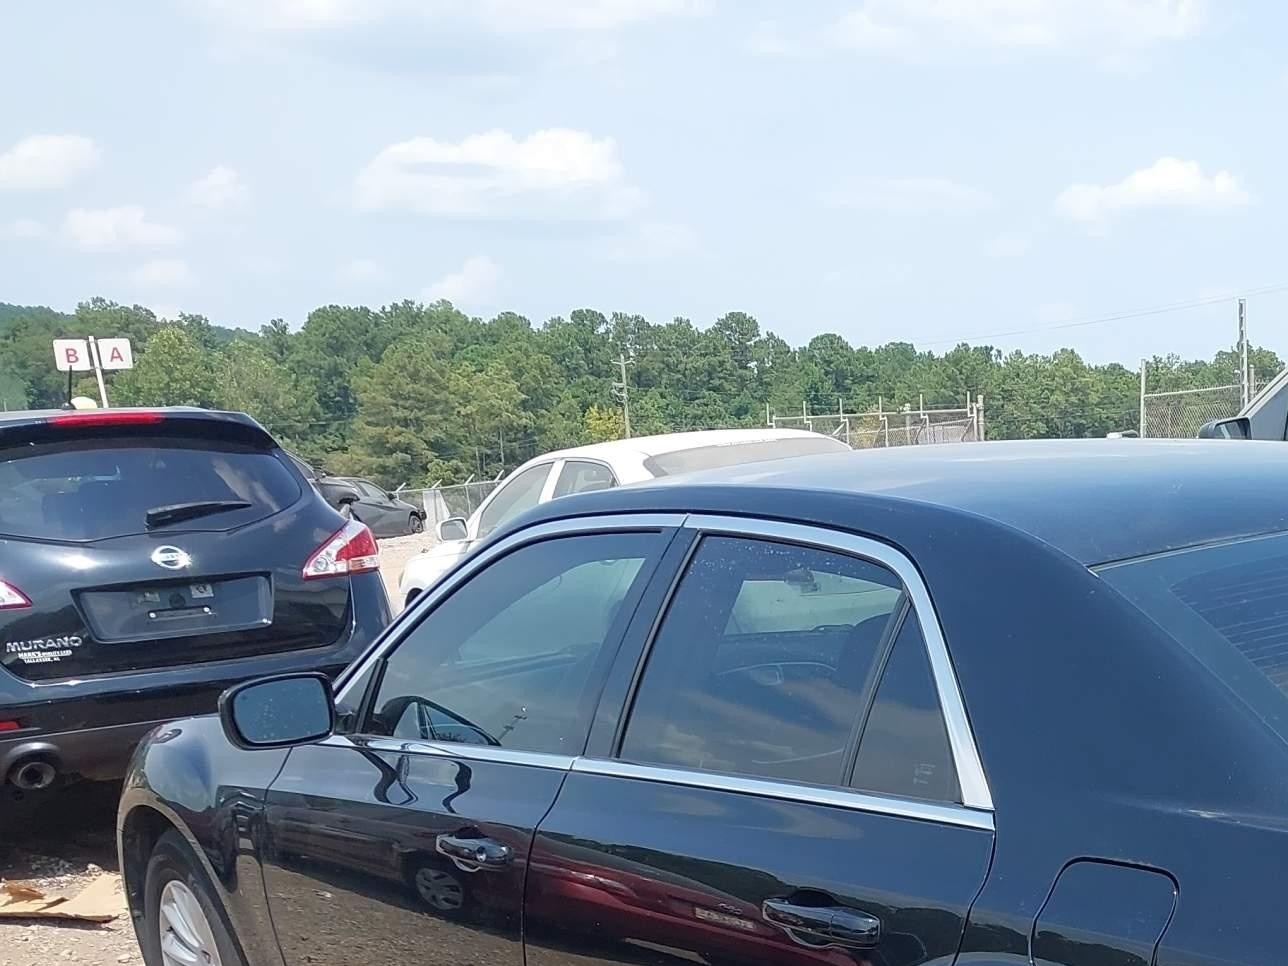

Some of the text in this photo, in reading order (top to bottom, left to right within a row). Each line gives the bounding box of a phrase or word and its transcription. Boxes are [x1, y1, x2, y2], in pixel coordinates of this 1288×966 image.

[65, 348, 79, 363] B
[110, 347, 124, 362] A
[6, 636, 82, 652] MURANO
